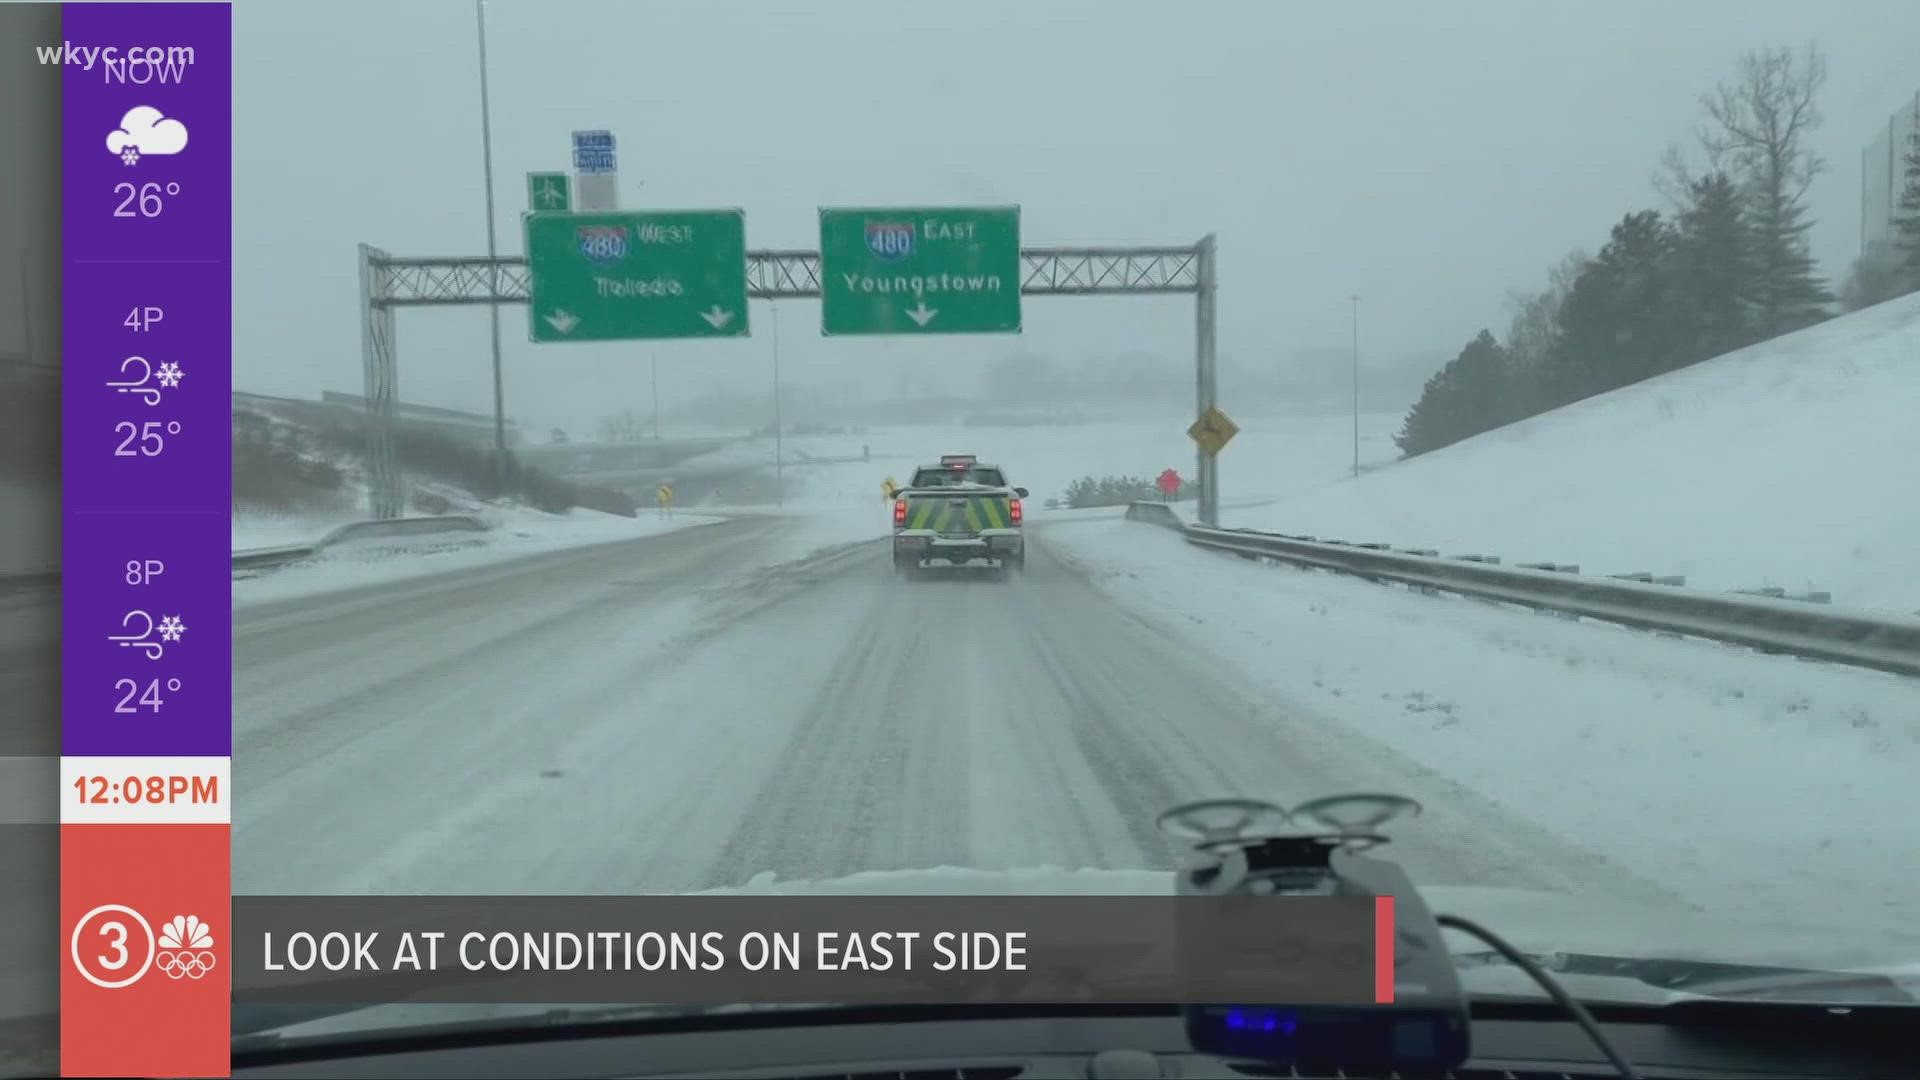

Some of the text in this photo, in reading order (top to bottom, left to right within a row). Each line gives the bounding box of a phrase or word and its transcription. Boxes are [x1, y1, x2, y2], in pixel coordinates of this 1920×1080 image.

[636, 223, 692, 243] WEST
[871, 220, 976, 253] 480 EAST
[593, 276, 684, 298] Toledo
[842, 272, 1001, 299] Youngstown
